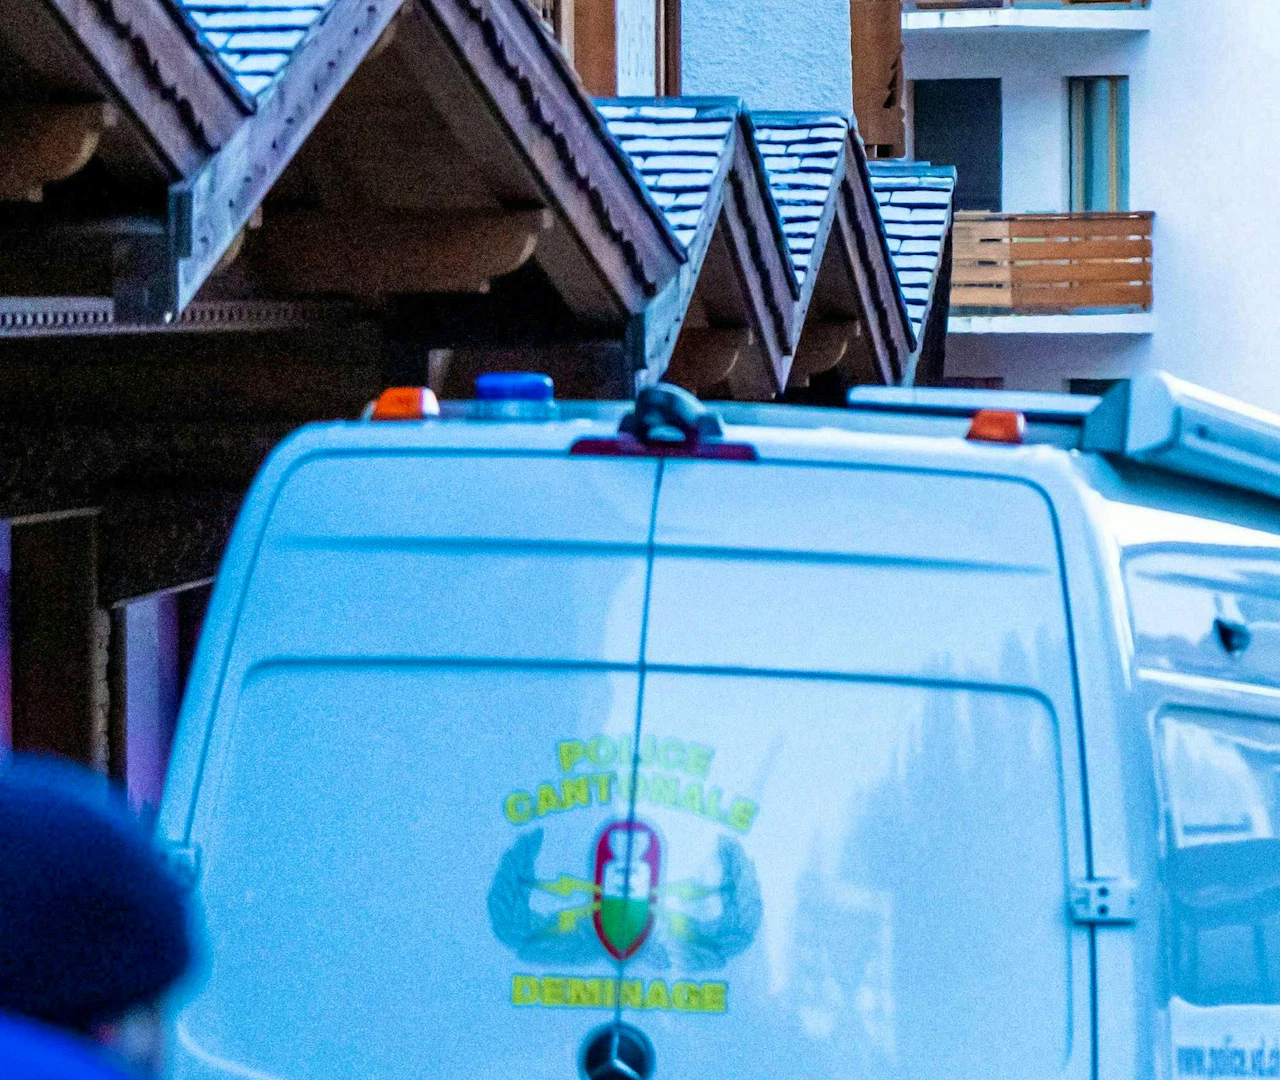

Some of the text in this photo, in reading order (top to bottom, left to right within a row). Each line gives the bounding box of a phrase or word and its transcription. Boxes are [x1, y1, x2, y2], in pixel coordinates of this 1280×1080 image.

[556, 736, 715, 778] POLICE
[503, 771, 758, 833] CANTONALE
[511, 974, 728, 1013] DEMINAGE
